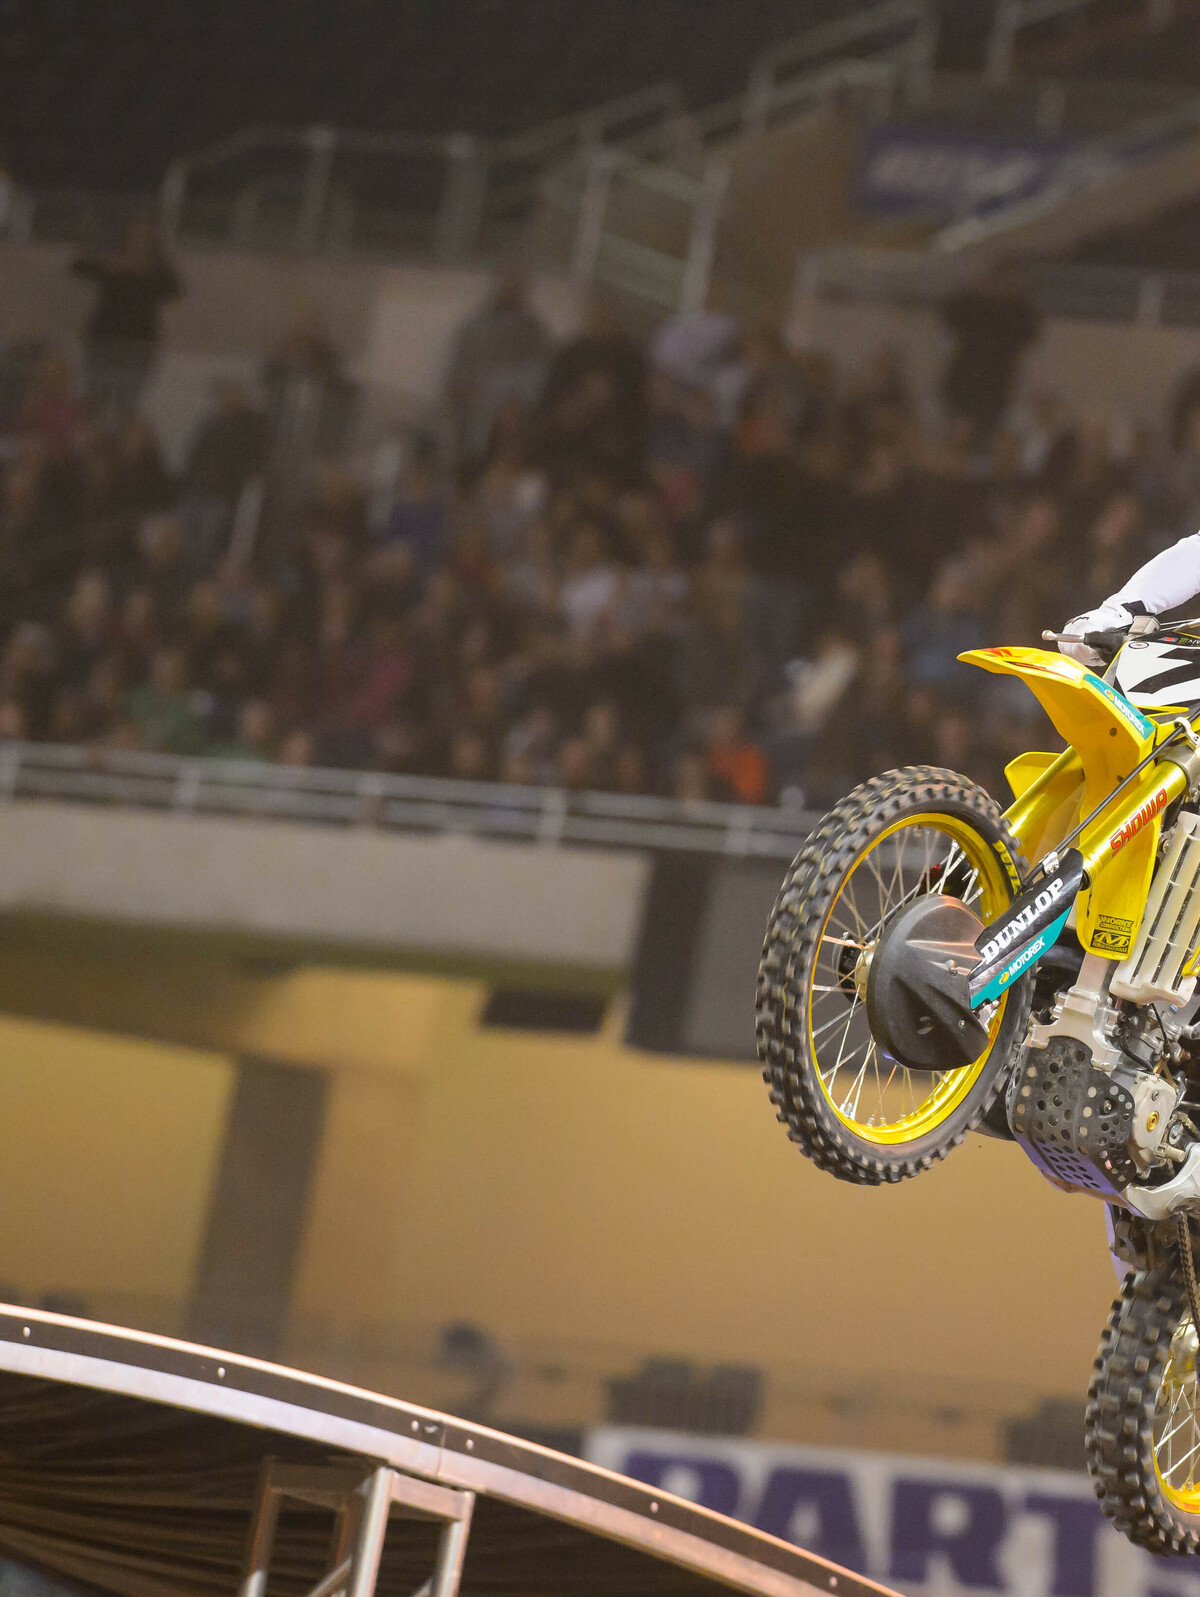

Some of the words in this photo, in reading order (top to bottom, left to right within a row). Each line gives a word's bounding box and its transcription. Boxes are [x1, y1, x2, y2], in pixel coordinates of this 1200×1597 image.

[1113, 695, 1145, 736] MOTOREX
[1110, 788, 1167, 858] SHOWA
[992, 839, 1023, 896] DUNL
[980, 877, 1064, 966] DUNLOP
[1008, 935, 1046, 977] MOTOREX
